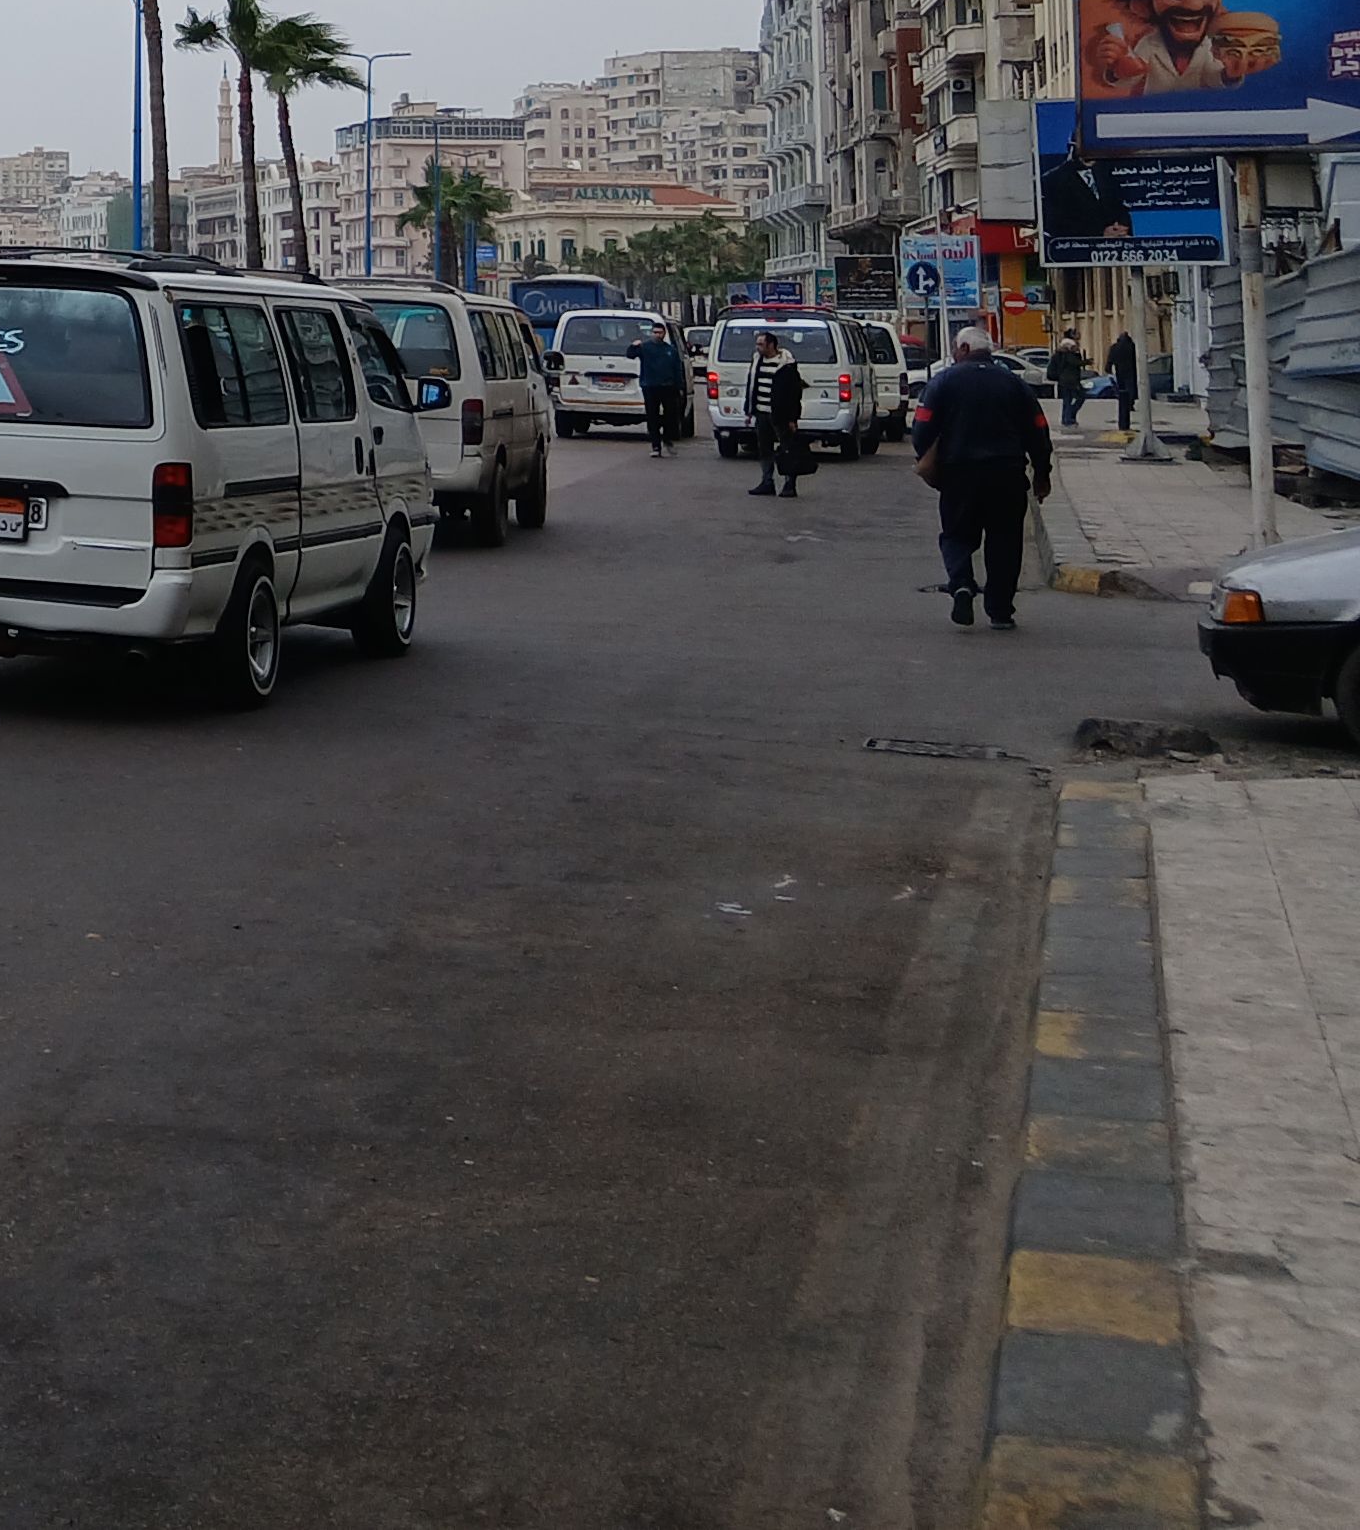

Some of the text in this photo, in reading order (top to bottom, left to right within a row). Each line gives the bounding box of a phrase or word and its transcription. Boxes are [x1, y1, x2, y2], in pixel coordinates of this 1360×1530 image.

[574, 188, 654, 203] ALEXBANK
[1090, 249, 1178, 262] 0122 666 2034
